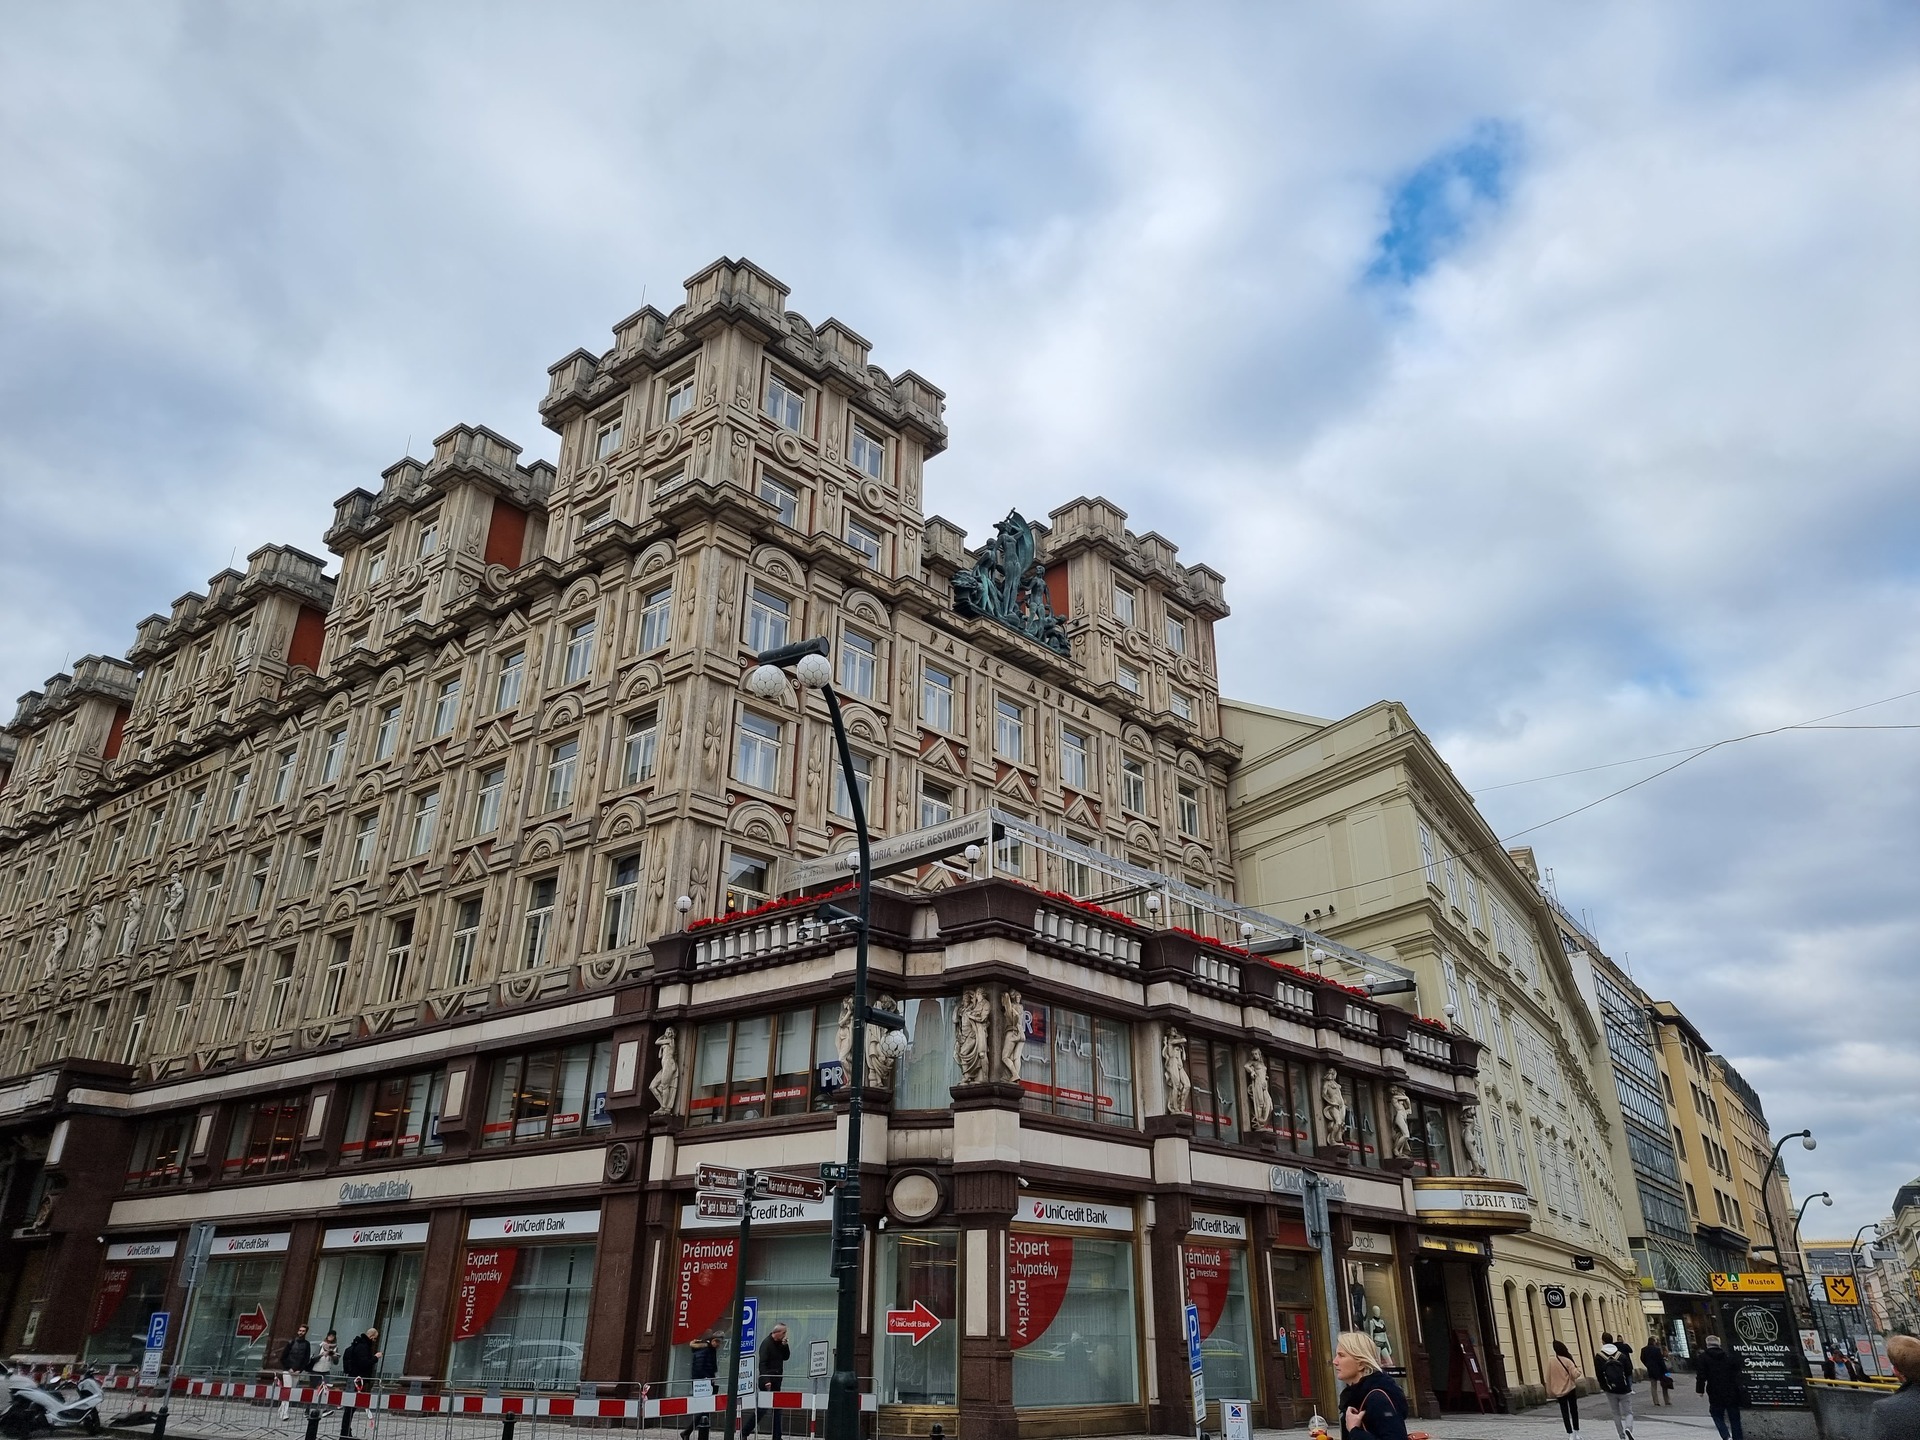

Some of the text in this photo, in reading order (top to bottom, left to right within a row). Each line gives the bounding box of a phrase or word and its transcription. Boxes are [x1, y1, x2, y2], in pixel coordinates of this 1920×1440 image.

[1026, 680, 1090, 720] ADRIA
[160, 763, 203, 791] ADRIA
[899, 835, 925, 854] CAFFÉ
[926, 821, 980, 847] RESTAURANT
[830, 1167, 839, 1177] WC
[349, 1179, 410, 1200] UniCredit Bank
[768, 1180, 804, 1195] Národní divadlo
[1464, 1194, 1506, 1208] ADRIA
[750, 1204, 805, 1220] Credit Bank
[1045, 1206, 1108, 1224] UniCredit Bank
[512, 1218, 566, 1233] UniCredit Bank
[1222, 1220, 1242, 1235] Bank
[360, 1228, 403, 1242] UniCredit Bank
[149, 1244, 160, 1255] Bank
[234, 1237, 270, 1250] UniCredit Bank
[682, 1240, 734, 1258] Prémiové
[1010, 1238, 1050, 1258] Expert
[467, 1252, 498, 1268] Expert
[1185, 1248, 1220, 1266] rémiové
[693, 1260, 728, 1274] a investice
[1016, 1260, 1058, 1280] hypotéky
[1196, 1268, 1218, 1278] investice
[470, 1268, 502, 1284] hypotéky
[678, 1262, 692, 1328] spoření
[462, 1286, 476, 1332] půjčky
[1016, 1280, 1030, 1338] půjčky
[1764, 1344, 1790, 1352] HRŮZA
